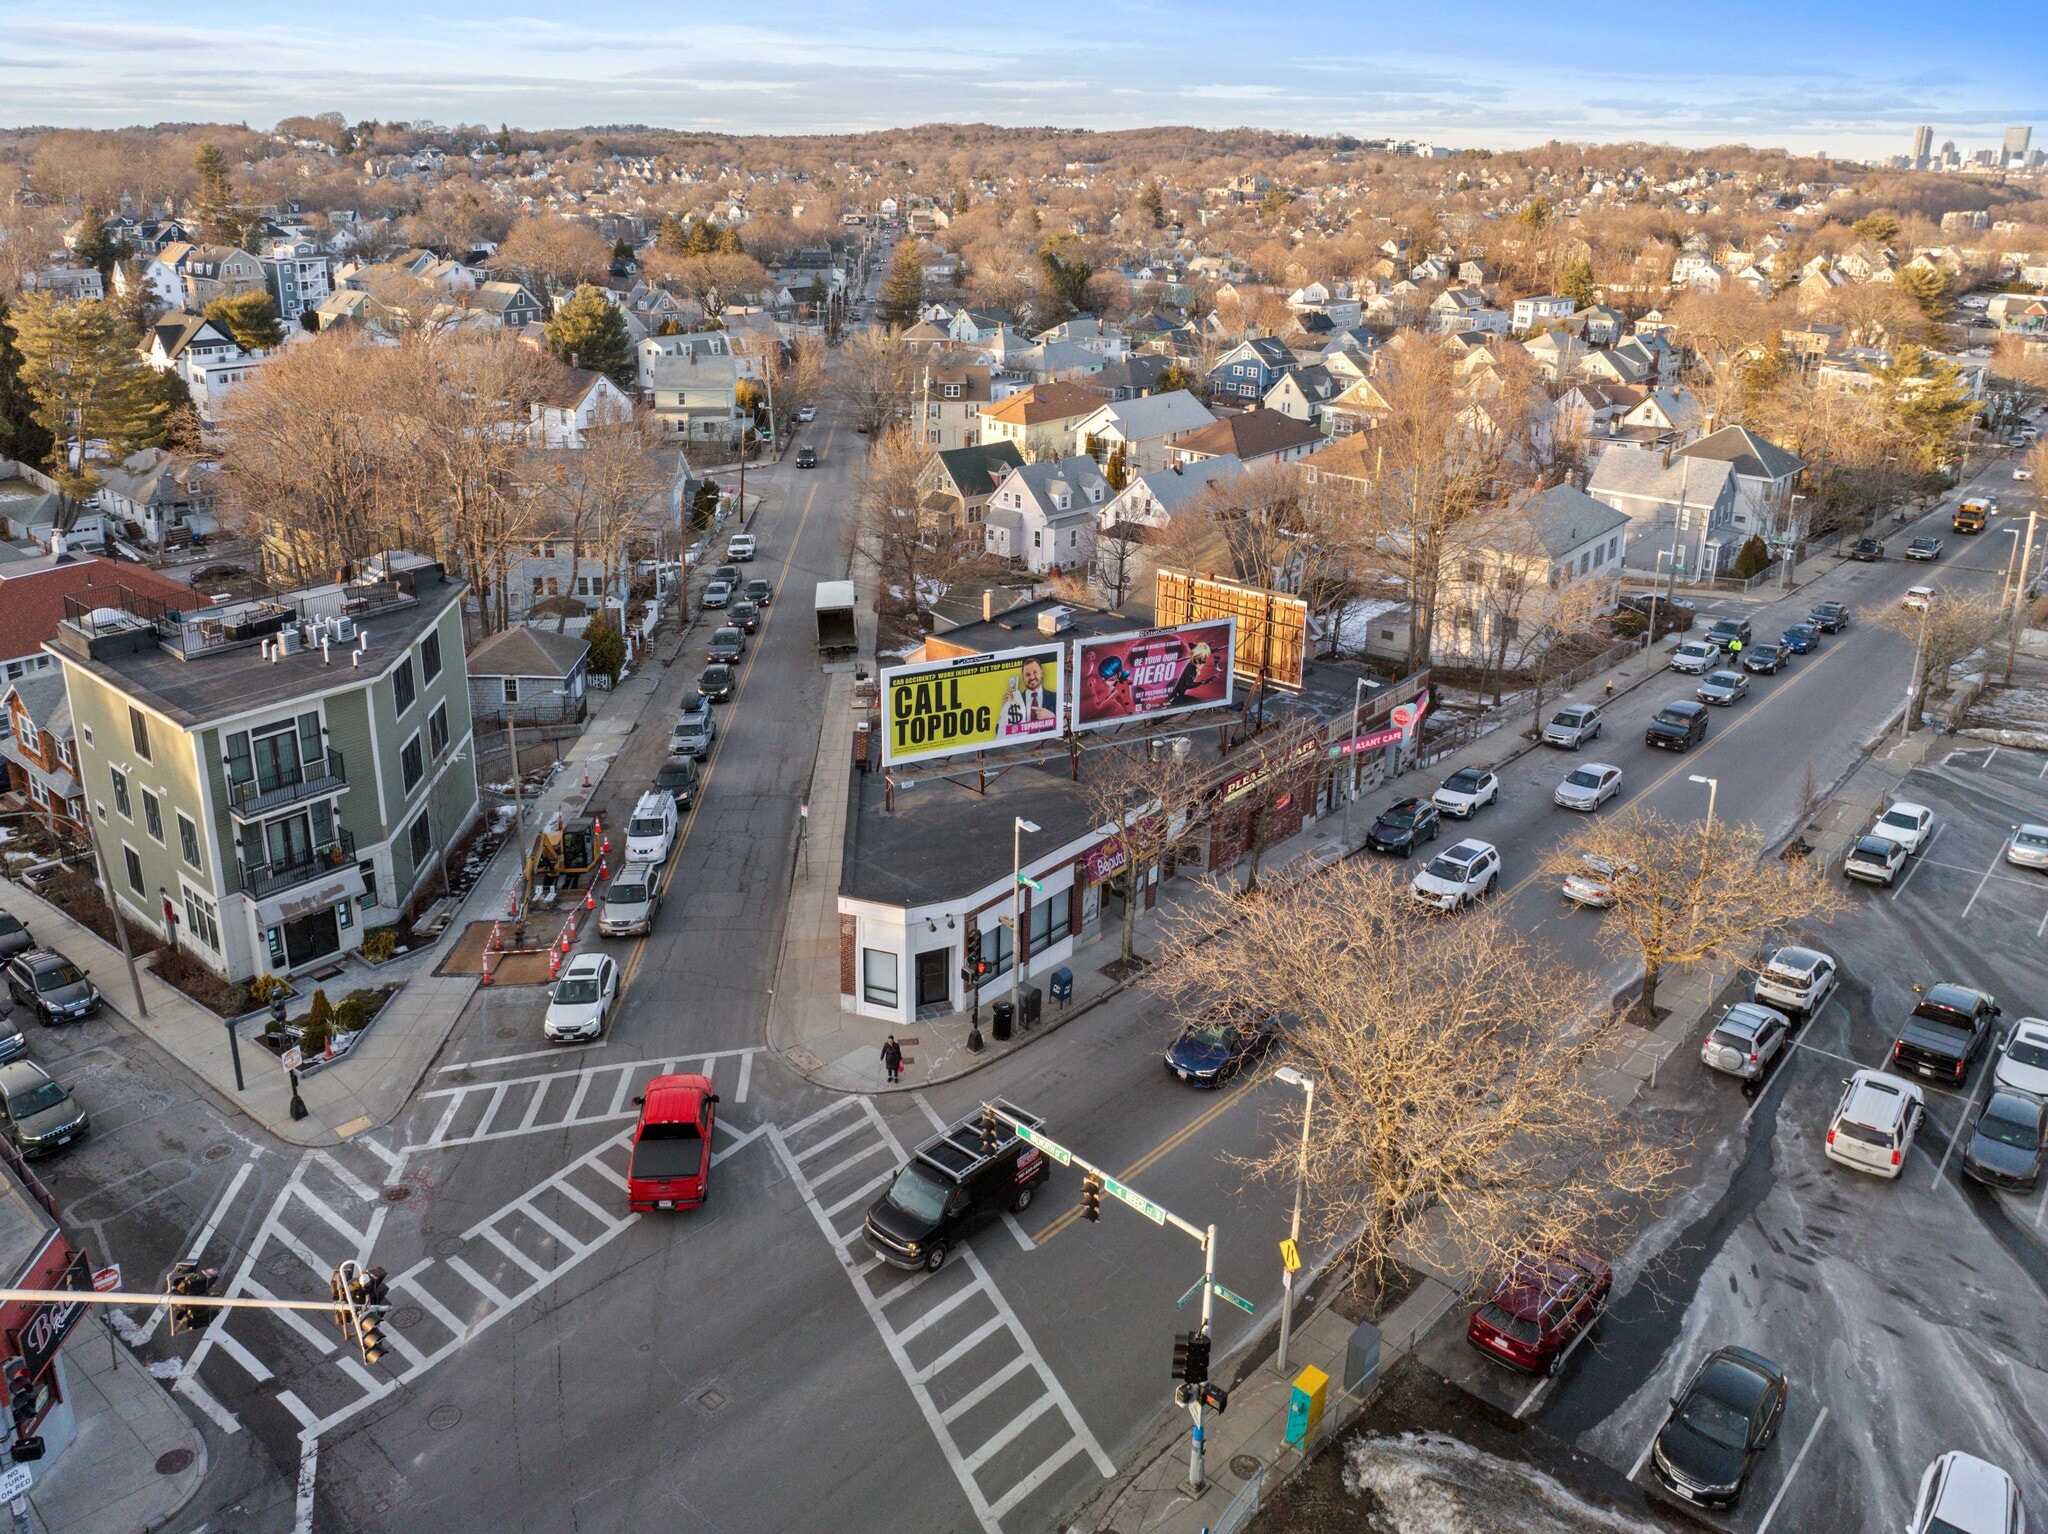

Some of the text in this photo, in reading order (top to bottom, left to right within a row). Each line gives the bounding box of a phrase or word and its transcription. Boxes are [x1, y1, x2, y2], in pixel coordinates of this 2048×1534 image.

[1134, 652, 1178, 667] BE YOUR OWN
[892, 660, 1023, 687] CAR ACCIDENT? WORK INJURY? GET TOP DOLLAR!
[1132, 661, 1176, 686] HERO
[895, 679, 962, 719] CALL
[895, 706, 991, 746] TOPDOG
[1020, 718, 1054, 731] TOPDOGLAW
[1342, 731, 1402, 753] PLASANT CAFE
[1126, 1192, 1146, 1212] BEECH
[97, 1280, 115, 1290] ENTER
[104, 1271, 116, 1279] NOT
[4, 1473, 25, 1489] TURN
[7, 1469, 19, 1480] NO
[1, 1478, 31, 1499] ON RED
